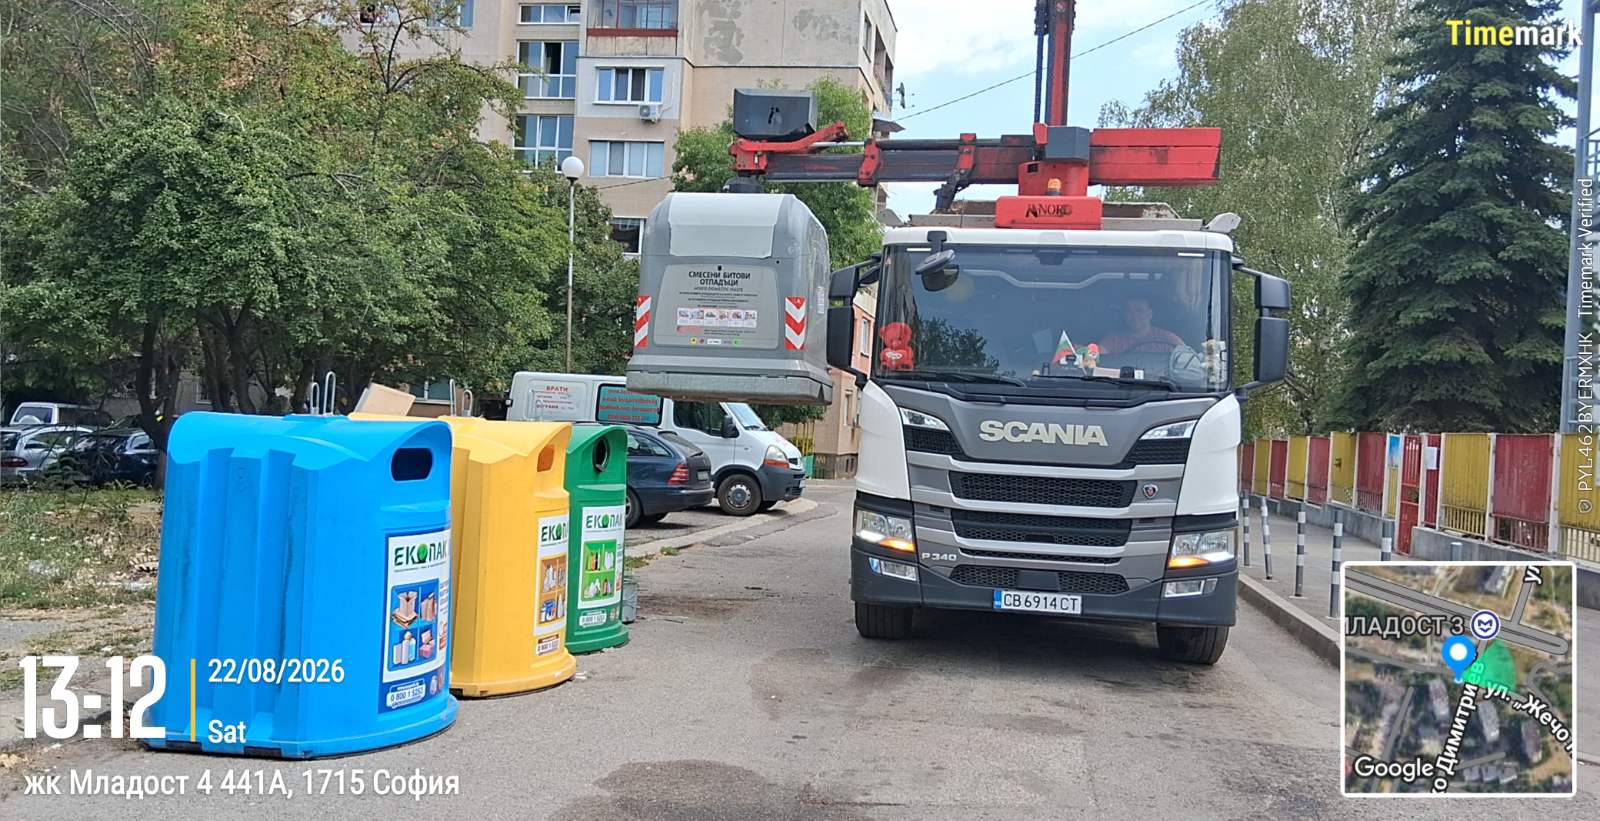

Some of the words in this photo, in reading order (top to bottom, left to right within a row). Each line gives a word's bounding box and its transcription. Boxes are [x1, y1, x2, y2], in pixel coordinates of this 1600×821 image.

[688, 271, 721, 279] СМЕСЕНИ
[723, 272, 751, 280] БИТОВИ
[700, 279, 739, 287] ОТПАДЪЦИ
[979, 420, 1109, 447] SCANIA
[394, 540, 448, 567] ЕКОПАК
